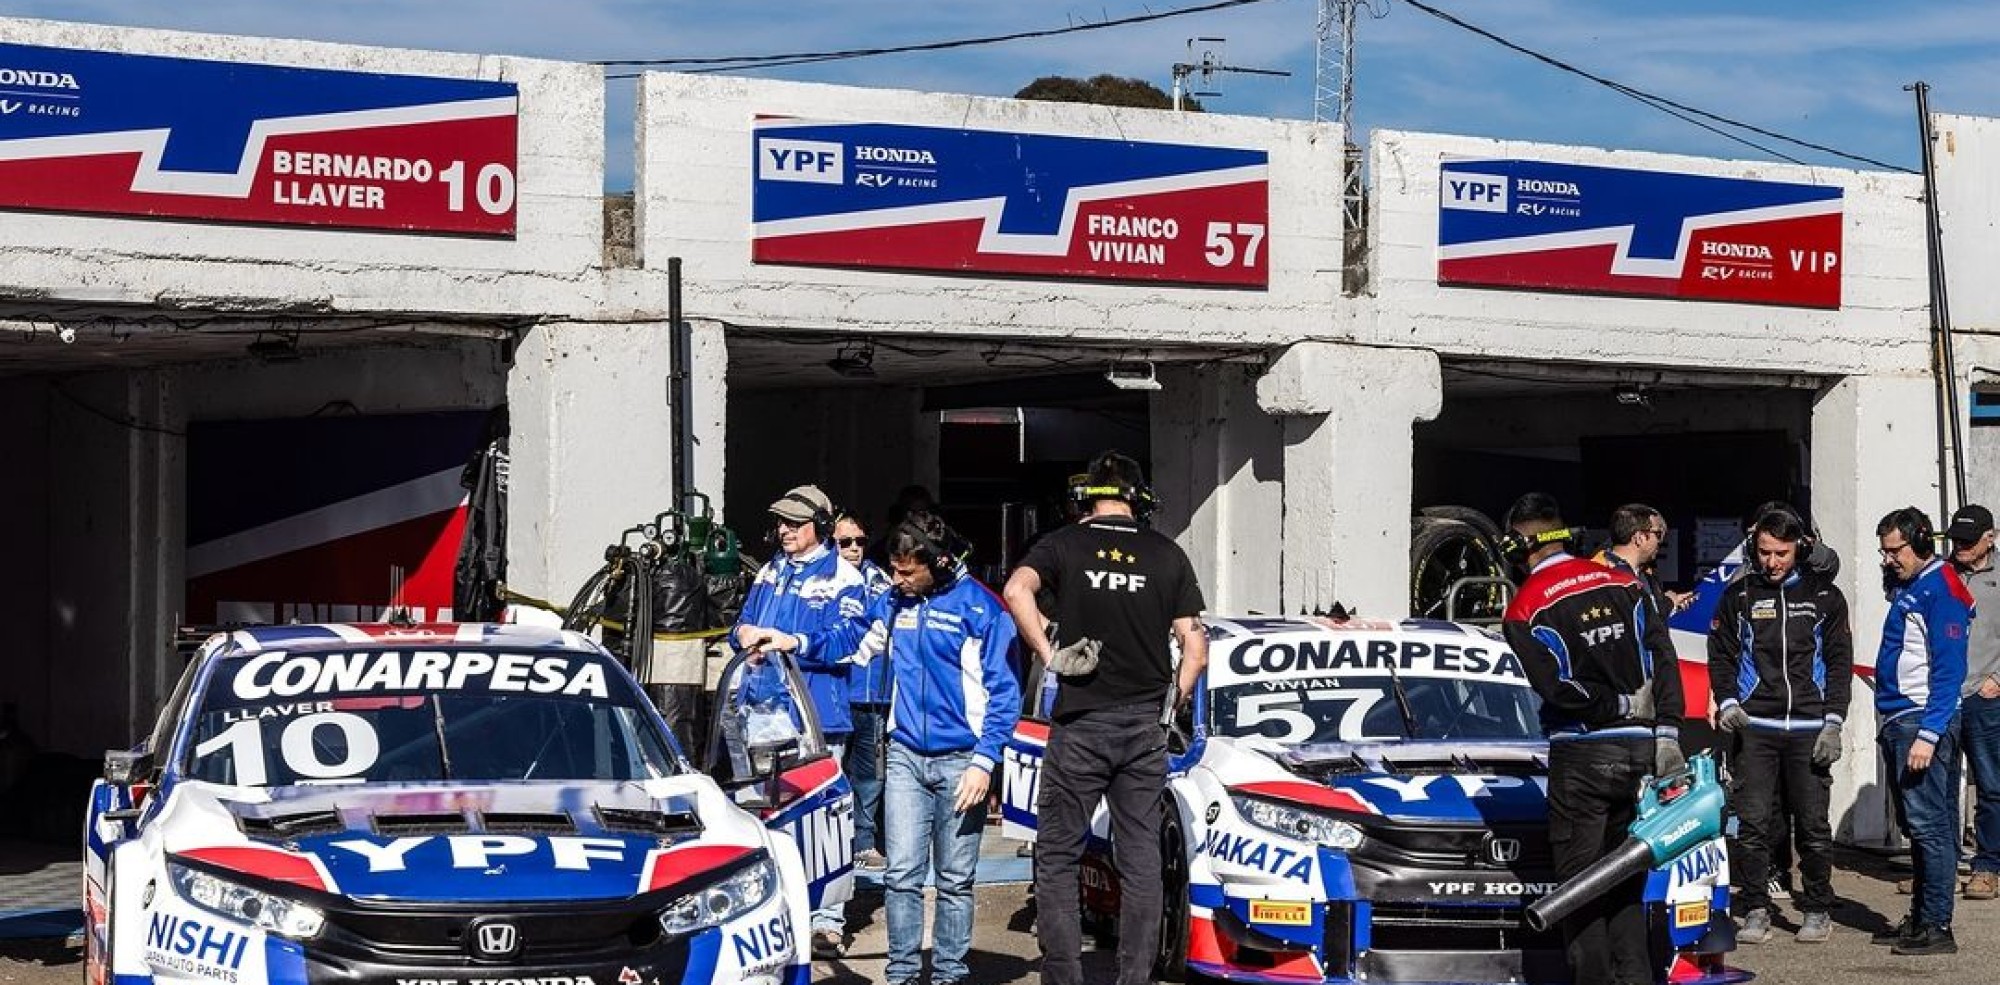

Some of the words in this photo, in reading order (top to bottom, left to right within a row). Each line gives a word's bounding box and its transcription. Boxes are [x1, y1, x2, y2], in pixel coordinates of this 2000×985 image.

[28, 103, 80, 117] RACING
[273, 150, 433, 184] BERNARDO
[769, 148, 836, 173] YPF
[855, 145, 937, 164] HONDA
[439, 161, 515, 216] 10
[855, 173, 893, 187] RV
[898, 177, 938, 188] RACING
[1450, 180, 1502, 203] YPF
[1517, 179, 1580, 196] HONDA
[273, 181, 386, 209] LLAVER
[1549, 206, 1580, 217] RACING
[1088, 214, 1179, 239] FRANCO
[1088, 240, 1166, 265] VIVIAN
[1204, 222, 1266, 268] 57
[1701, 240, 1773, 260] HONDA
[1790, 249, 1838, 274] VIP
[1738, 269, 1773, 280] RACING
[1085, 570, 1147, 593] YPF
[1544, 579, 1577, 598] Honda
[1580, 622, 1625, 647] YPF
[232, 651, 609, 699] CONARPESA
[1263, 678, 1341, 692] VIVIAN
[224, 701, 335, 723] LLAVER
[1236, 688, 1385, 743] 57
[196, 712, 380, 788] 10
[1660, 818, 1702, 847] Makita
[329, 836, 627, 872] YPF
[1196, 828, 1314, 884] NAKATA
[1428, 882, 1476, 895] YPF
[1254, 904, 1306, 921] PIRELLI
[147, 912, 249, 970] NISHI
[166, 957, 194, 973] AUTO
[197, 964, 238, 984] PARTS
